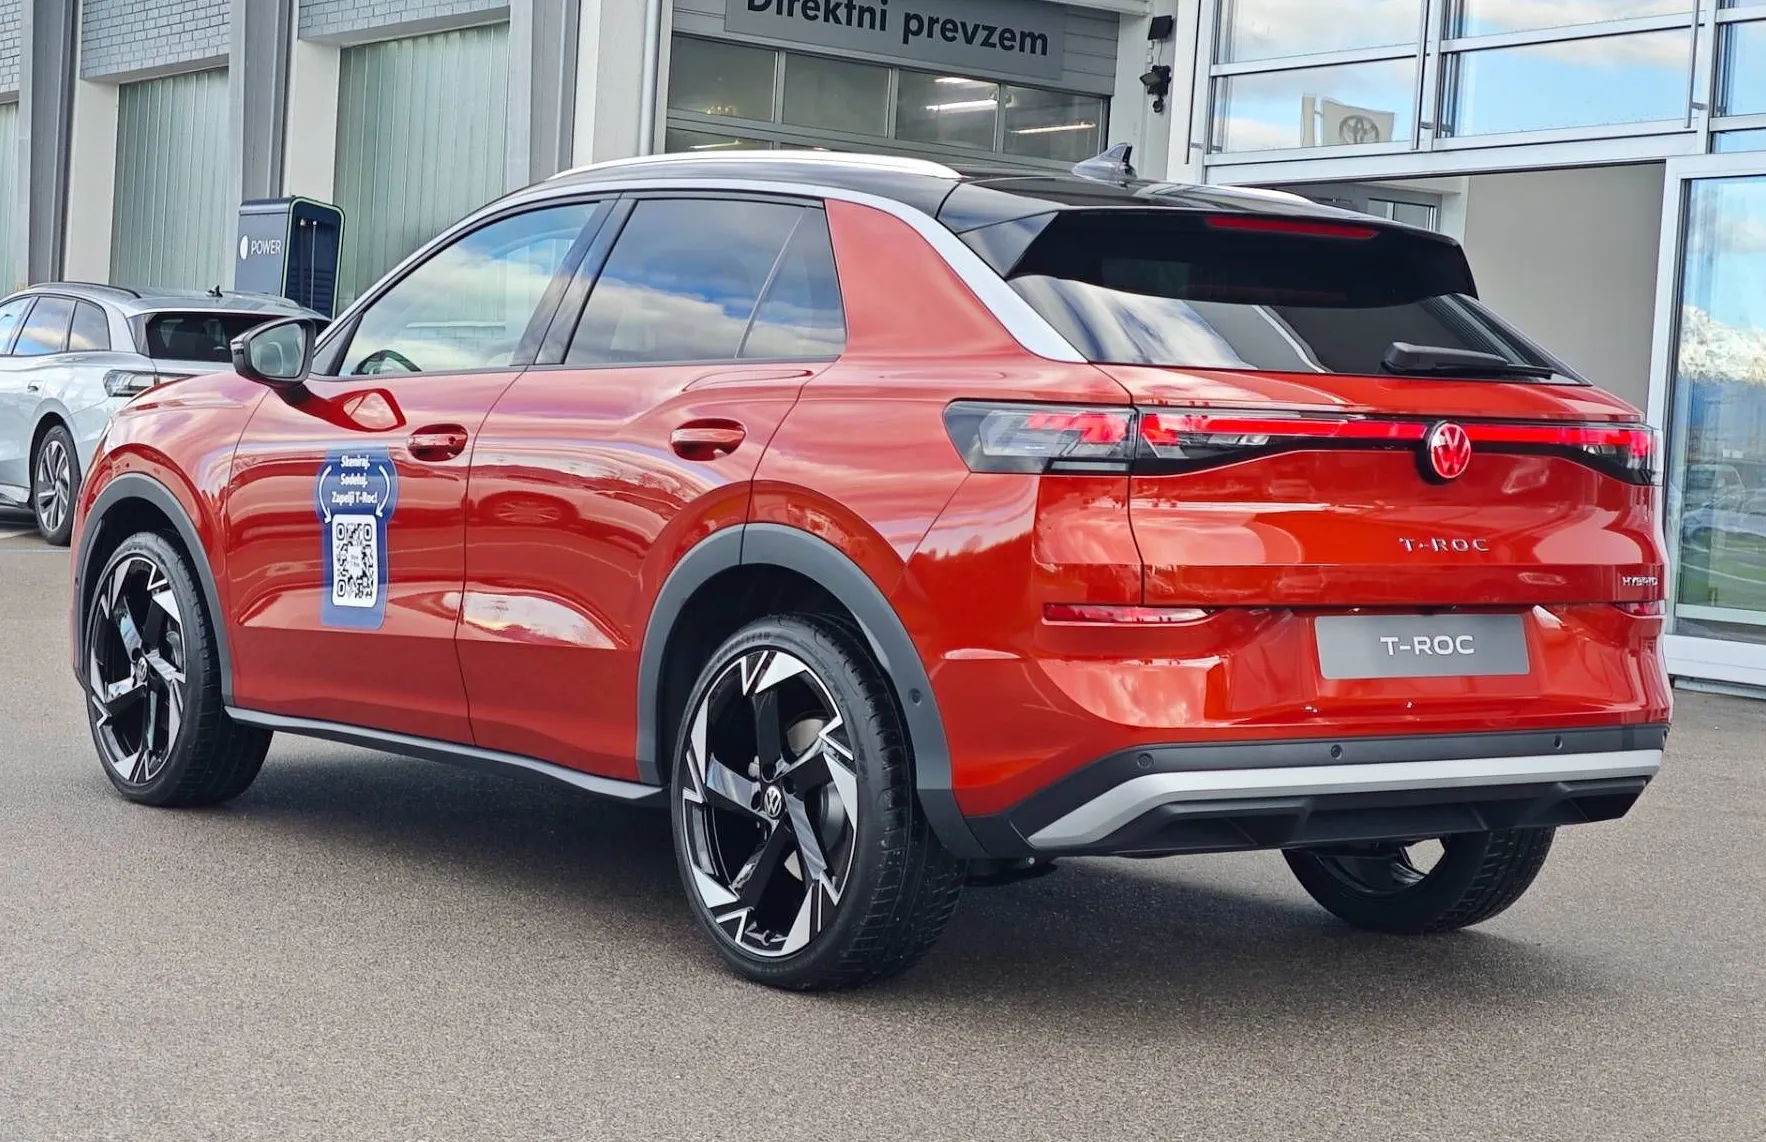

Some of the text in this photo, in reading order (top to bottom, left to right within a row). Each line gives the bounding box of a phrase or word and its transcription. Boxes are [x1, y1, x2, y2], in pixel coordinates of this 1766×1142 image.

[902, 11, 1049, 56] prevzem
[250, 240, 281, 255] POWER
[1398, 537, 1490, 552] T-ROC
[1622, 576, 1659, 587] HYBRID
[1379, 634, 1476, 656] T-ROC
